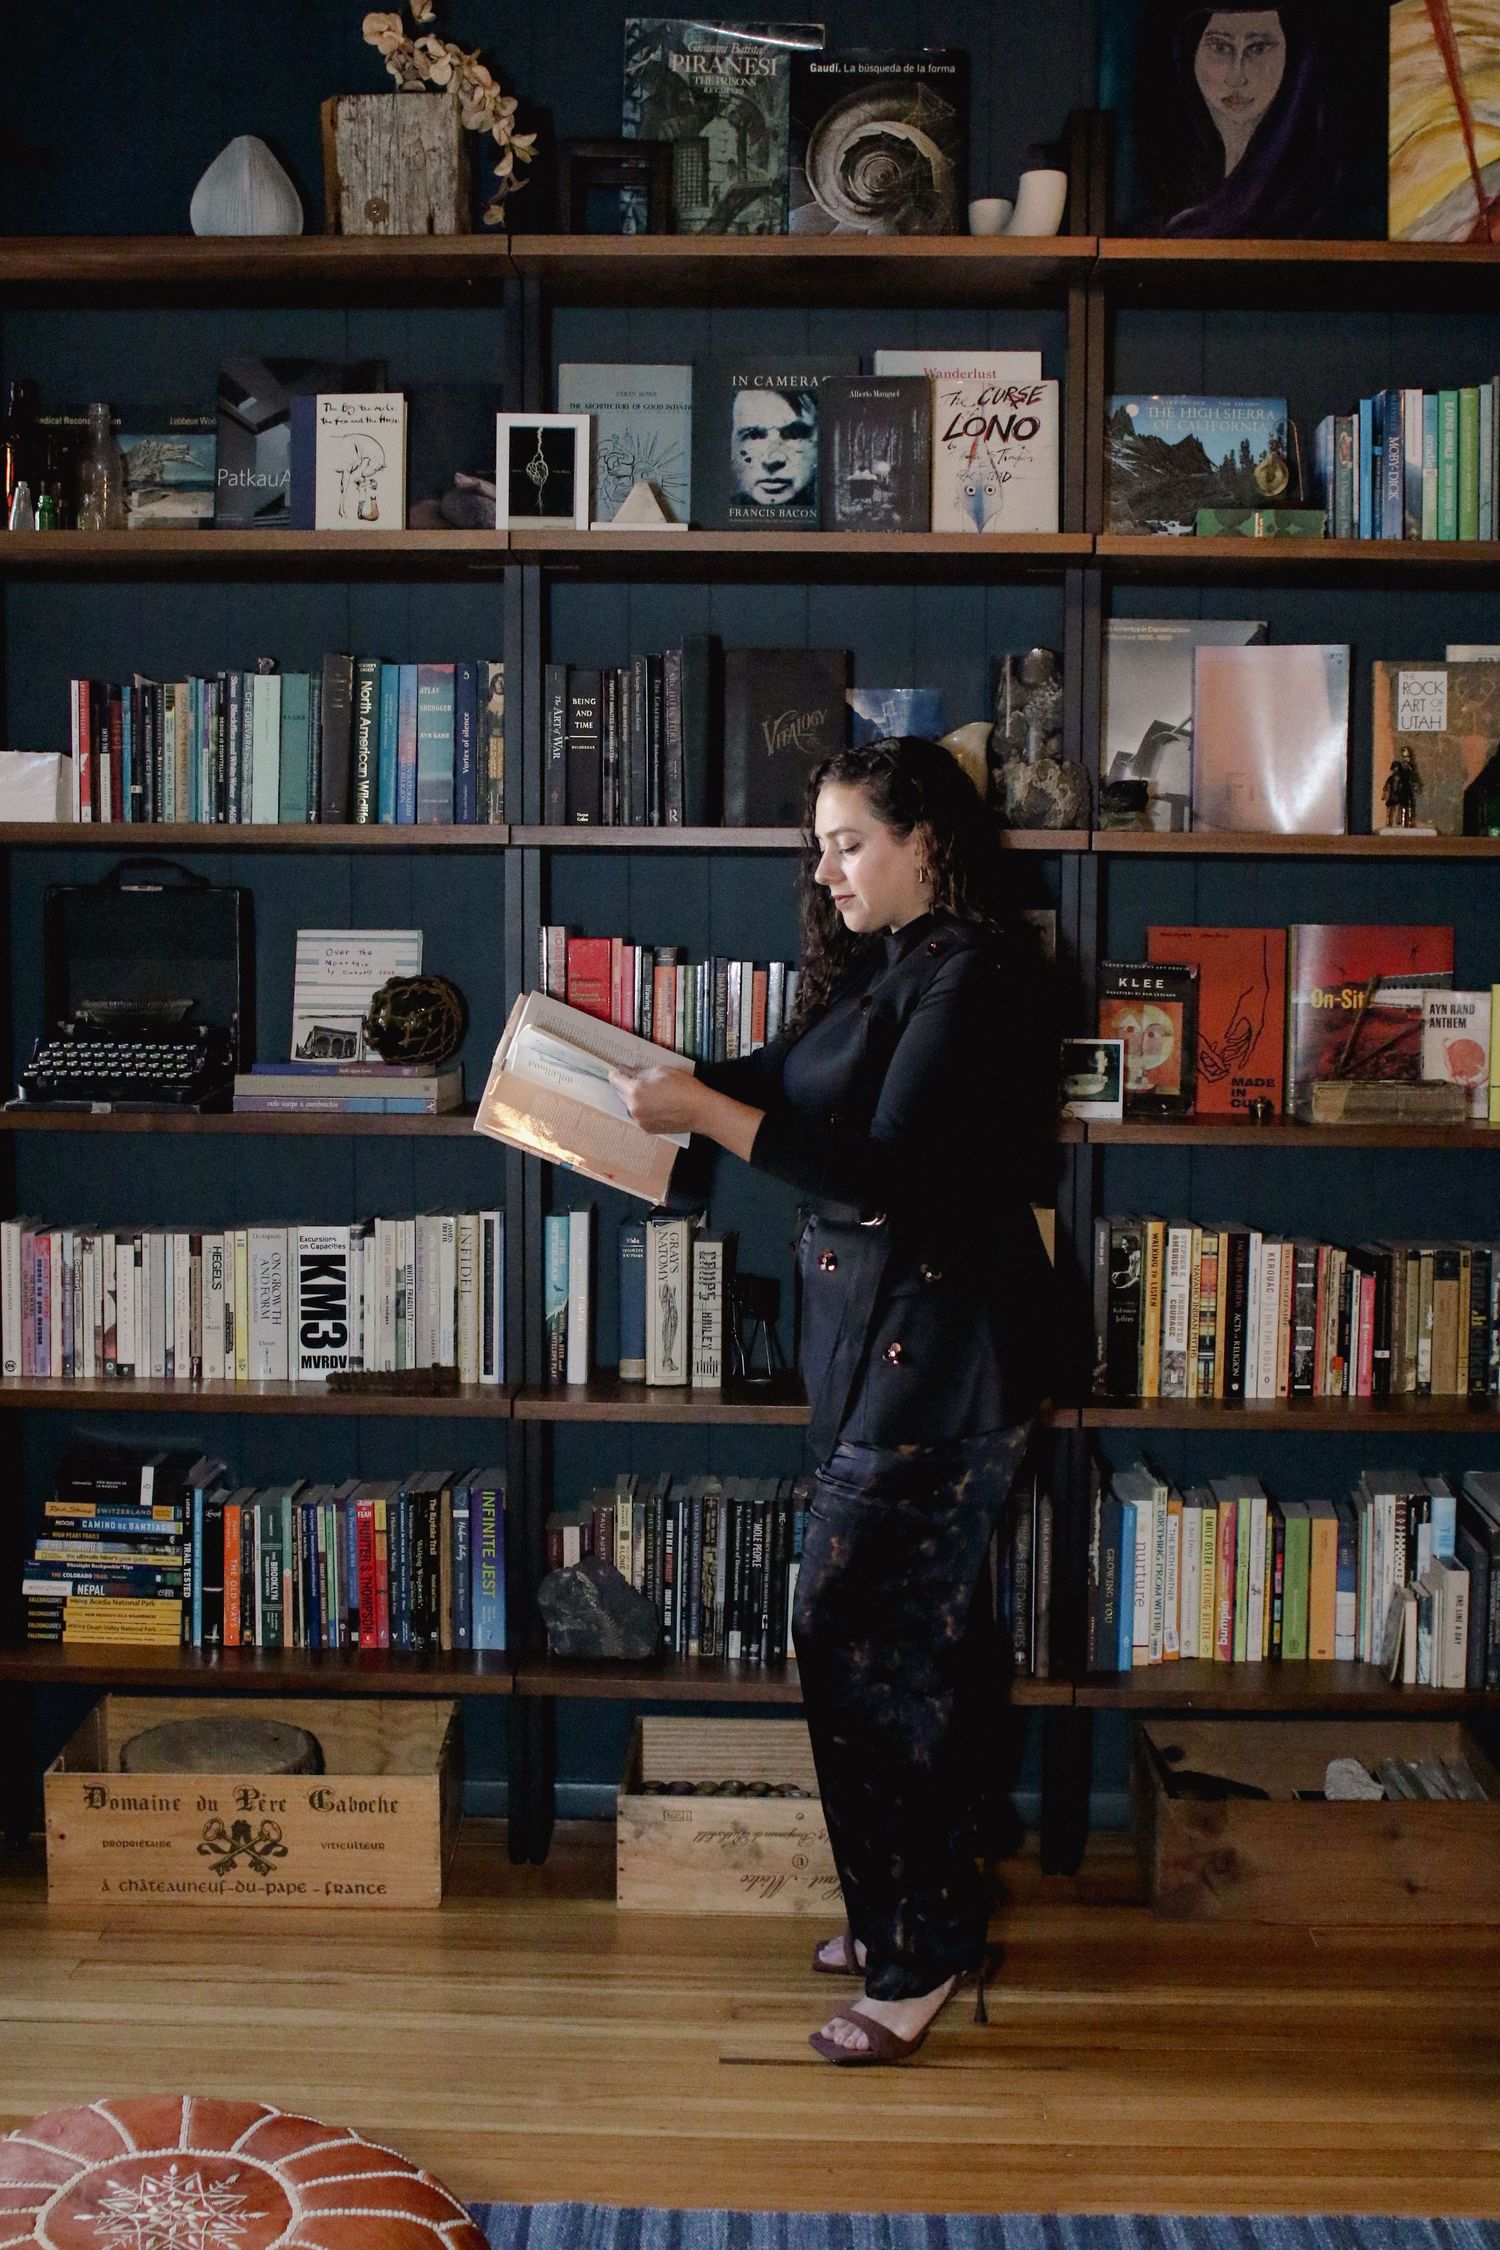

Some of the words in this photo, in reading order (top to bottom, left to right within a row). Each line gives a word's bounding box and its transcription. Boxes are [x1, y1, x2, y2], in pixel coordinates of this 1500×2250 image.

[672, 54, 778, 76] PIRANESI
[810, 62, 841, 73] Gaudí.
[844, 63, 856, 73] La
[858, 63, 901, 75] búsqueda
[903, 64, 915, 73] de
[917, 63, 926, 73] la
[928, 63, 956, 73] forma
[732, 376, 748, 387] IN
[754, 376, 819, 388] CAMERA
[923, 367, 997, 379] Wanderlust
[977, 385, 1048, 409] CURSE
[1149, 407, 1177, 420] THE
[1181, 407, 1217, 420] HIGH
[1220, 408, 1275, 420] SIERRA
[1154, 420, 1177, 431] OF
[942, 412, 1041, 443] LONO
[1388, 436, 1400, 501] MOBY-DICK
[729, 511, 776, 523] FRANCIS
[779, 511, 817, 523] BACON
[230, 676, 238, 698] Sloan
[359, 680, 373, 714] North
[1402, 681, 1444, 695] ROCK
[244, 692, 252, 709] CHE
[553, 695, 564, 706] The
[1400, 698, 1425, 713] ART
[553, 706, 564, 729] ART
[1401, 715, 1441, 730] UTAH
[244, 711, 252, 750] GUEVARA
[463, 738, 470, 747] of
[358, 717, 371, 777] American
[553, 736, 564, 759] WAR
[463, 749, 471, 775] Vortex
[356, 779, 370, 824] Wildlife
[406, 773, 414, 817] NATURALISM
[326, 948, 350, 957] Over
[359, 948, 373, 956] the
[1118, 977, 1164, 989] KLEE
[644, 984, 652, 1011] Drawing
[1429, 1004, 1448, 1016] AYN
[1450, 1004, 1476, 1016] RAND
[717, 1007, 725, 1029] BUMS
[1429, 1018, 1467, 1029] ANTHEM
[1231, 1078, 1275, 1087] MADE
[1231, 1089, 1246, 1098] IN
[311, 1243, 346, 1251] Capacities
[658, 1231, 669, 1282] NATOMY
[669, 1232, 680, 1274] GRAY'S
[1151, 1232, 1160, 1268] WALKING
[1171, 1234, 1180, 1277] AMBROSE
[260, 1258, 271, 1284] AND
[271, 1253, 282, 1269] ON
[461, 1227, 472, 1299] INFIDEL
[1265, 1252, 1276, 1293] KEROUAC
[406, 1264, 414, 1286] WHITE
[699, 1250, 717, 1301] CAMPS
[1191, 1264, 1201, 1302] NAVAHO
[260, 1287, 271, 1320] FORM
[271, 1272, 282, 1326] GROWTH
[300, 1254, 347, 1349] KM3
[406, 1289, 414, 1322] FRAGILITY
[1149, 1280, 1157, 1308] LISTEN
[1168, 1299, 1178, 1338] COURAGE
[1190, 1304, 1199, 1330] INDIAN
[1233, 1312, 1242, 1332] ACTS
[1264, 1314, 1273, 1326] ON
[702, 1312, 713, 1350] HAILEY
[1263, 1328, 1272, 1345] THE
[1189, 1333, 1198, 1359] MYTHS
[301, 1355, 347, 1368] MVRDV
[1231, 1340, 1241, 1378] RELIGION
[1262, 1349, 1272, 1374] ROAD
[97, 1508, 152, 1517] SWITZERLAND
[481, 1491, 496, 1559] INFINITE
[82, 1520, 117, 1531] CAMINO
[129, 1522, 173, 1532] SANTIAGO
[752, 1522, 763, 1542] MOLE
[1156, 1510, 1165, 1561] BIRTHING
[1167, 1528, 1176, 1542] THE
[1205, 1516, 1214, 1538] EMILY
[361, 1520, 371, 1560] HUNTER
[184, 1542, 192, 1570] TRAIL
[752, 1543, 763, 1568] PEOPLE
[1167, 1544, 1176, 1567] BIRTH
[1204, 1541, 1213, 1565] OSTER
[271, 1561, 279, 1601] BROOKLYN
[361, 1565, 371, 1575] S.
[482, 1561, 496, 1598] JEST
[1106, 1548, 1115, 1598] GROWING
[1135, 1541, 1147, 1608] nurture
[1154, 1563, 1165, 1597] FROM
[77, 1584, 106, 1596] NEPAL
[184, 1572, 192, 1598] TESTED
[1167, 1567, 1176, 1601] PARTNER
[1203, 1568, 1212, 1609] EXPECTING
[361, 1576, 374, 1634] THOMPSON
[1106, 1602, 1115, 1624] YOU
[1455, 1594, 1464, 1607] ONE
[1202, 1613, 1211, 1640] BETTER
[1455, 1609, 1464, 1623] LINE
[1455, 1632, 1464, 1646] DAY
[83, 1784, 181, 1814] Domaine
[196, 1796, 219, 1814] du
